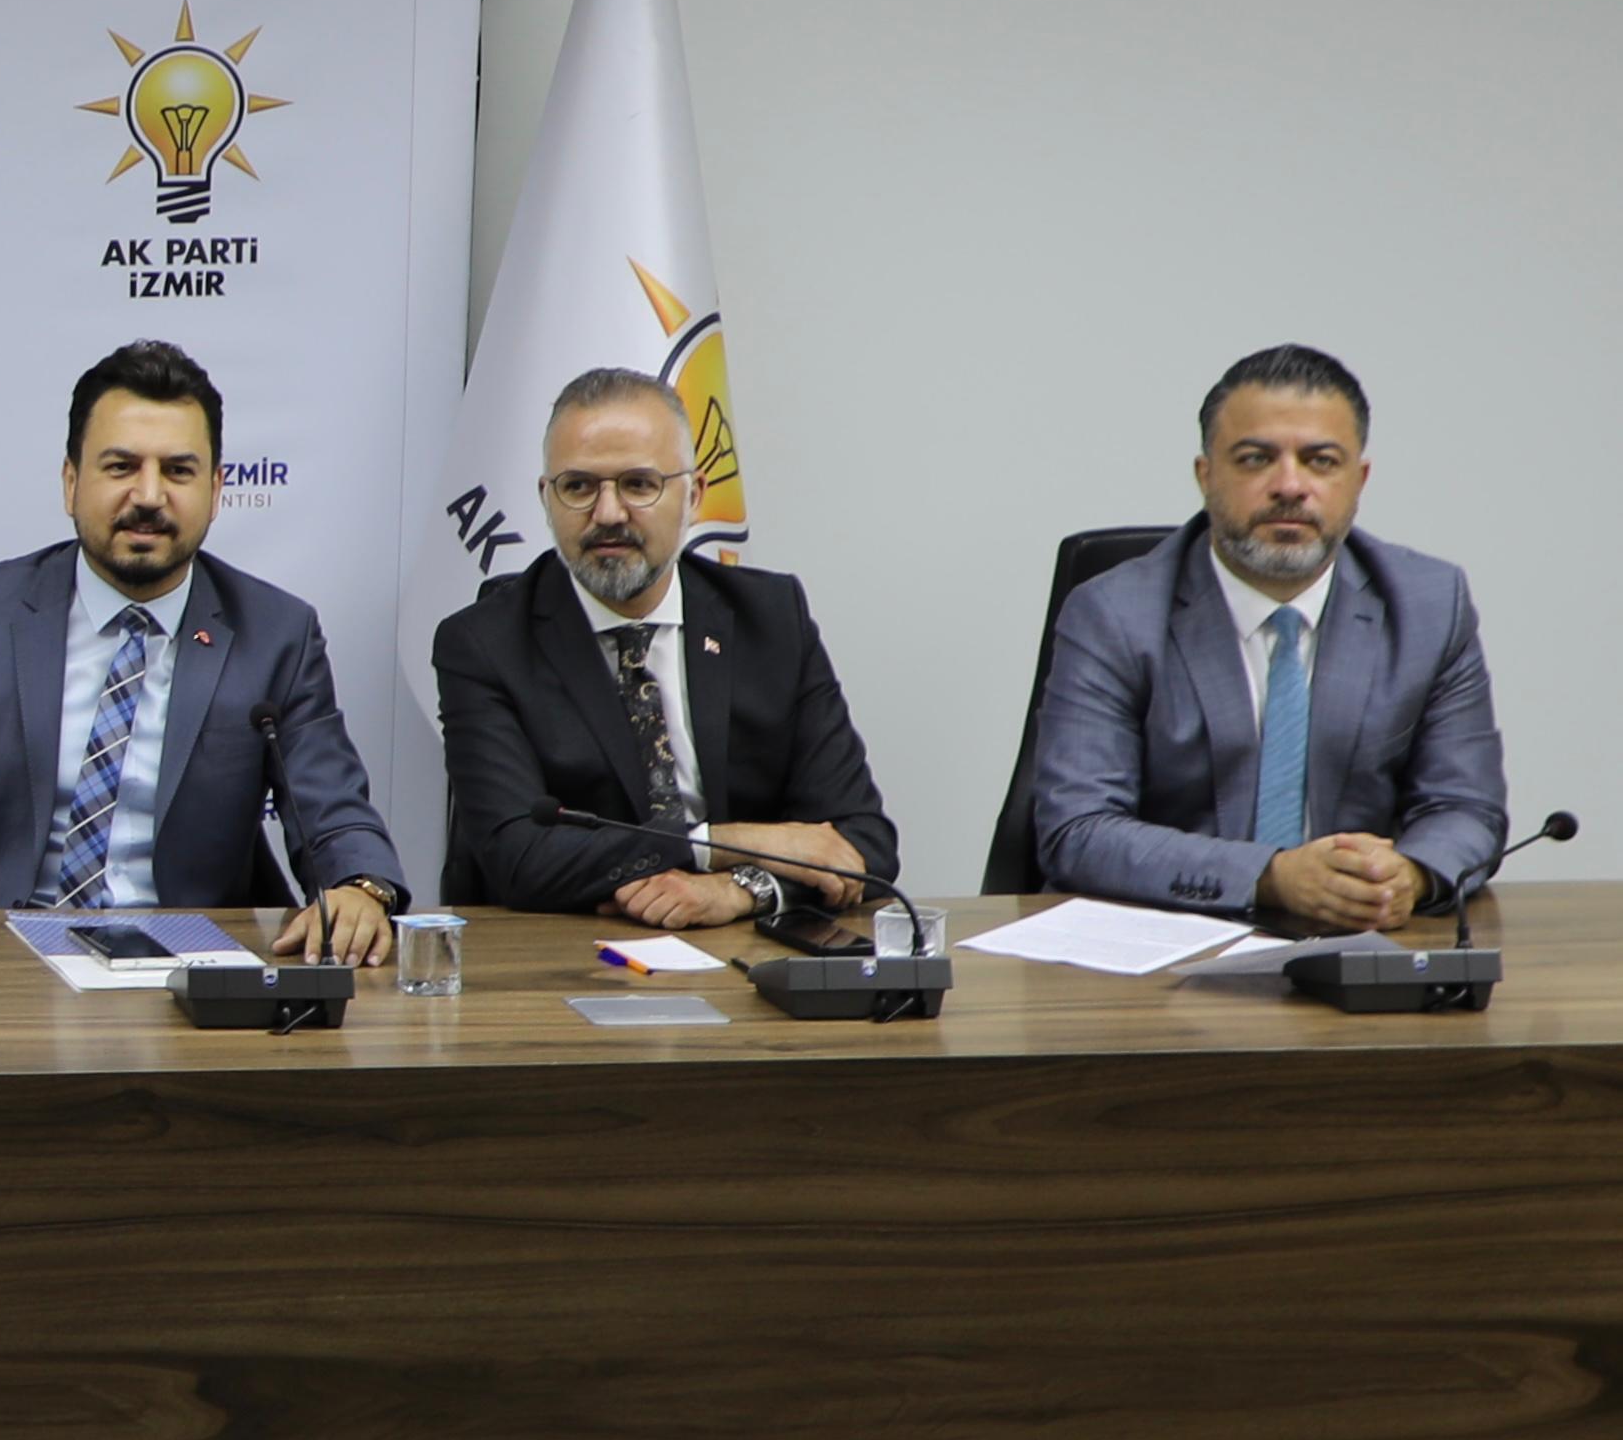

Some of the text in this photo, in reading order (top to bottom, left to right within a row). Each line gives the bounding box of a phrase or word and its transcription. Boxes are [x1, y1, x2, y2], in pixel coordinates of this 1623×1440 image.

[101, 239, 152, 266] AK
[223, 457, 288, 486] ZMİR
[222, 493, 271, 507] NTISI
[446, 484, 525, 576] AK
